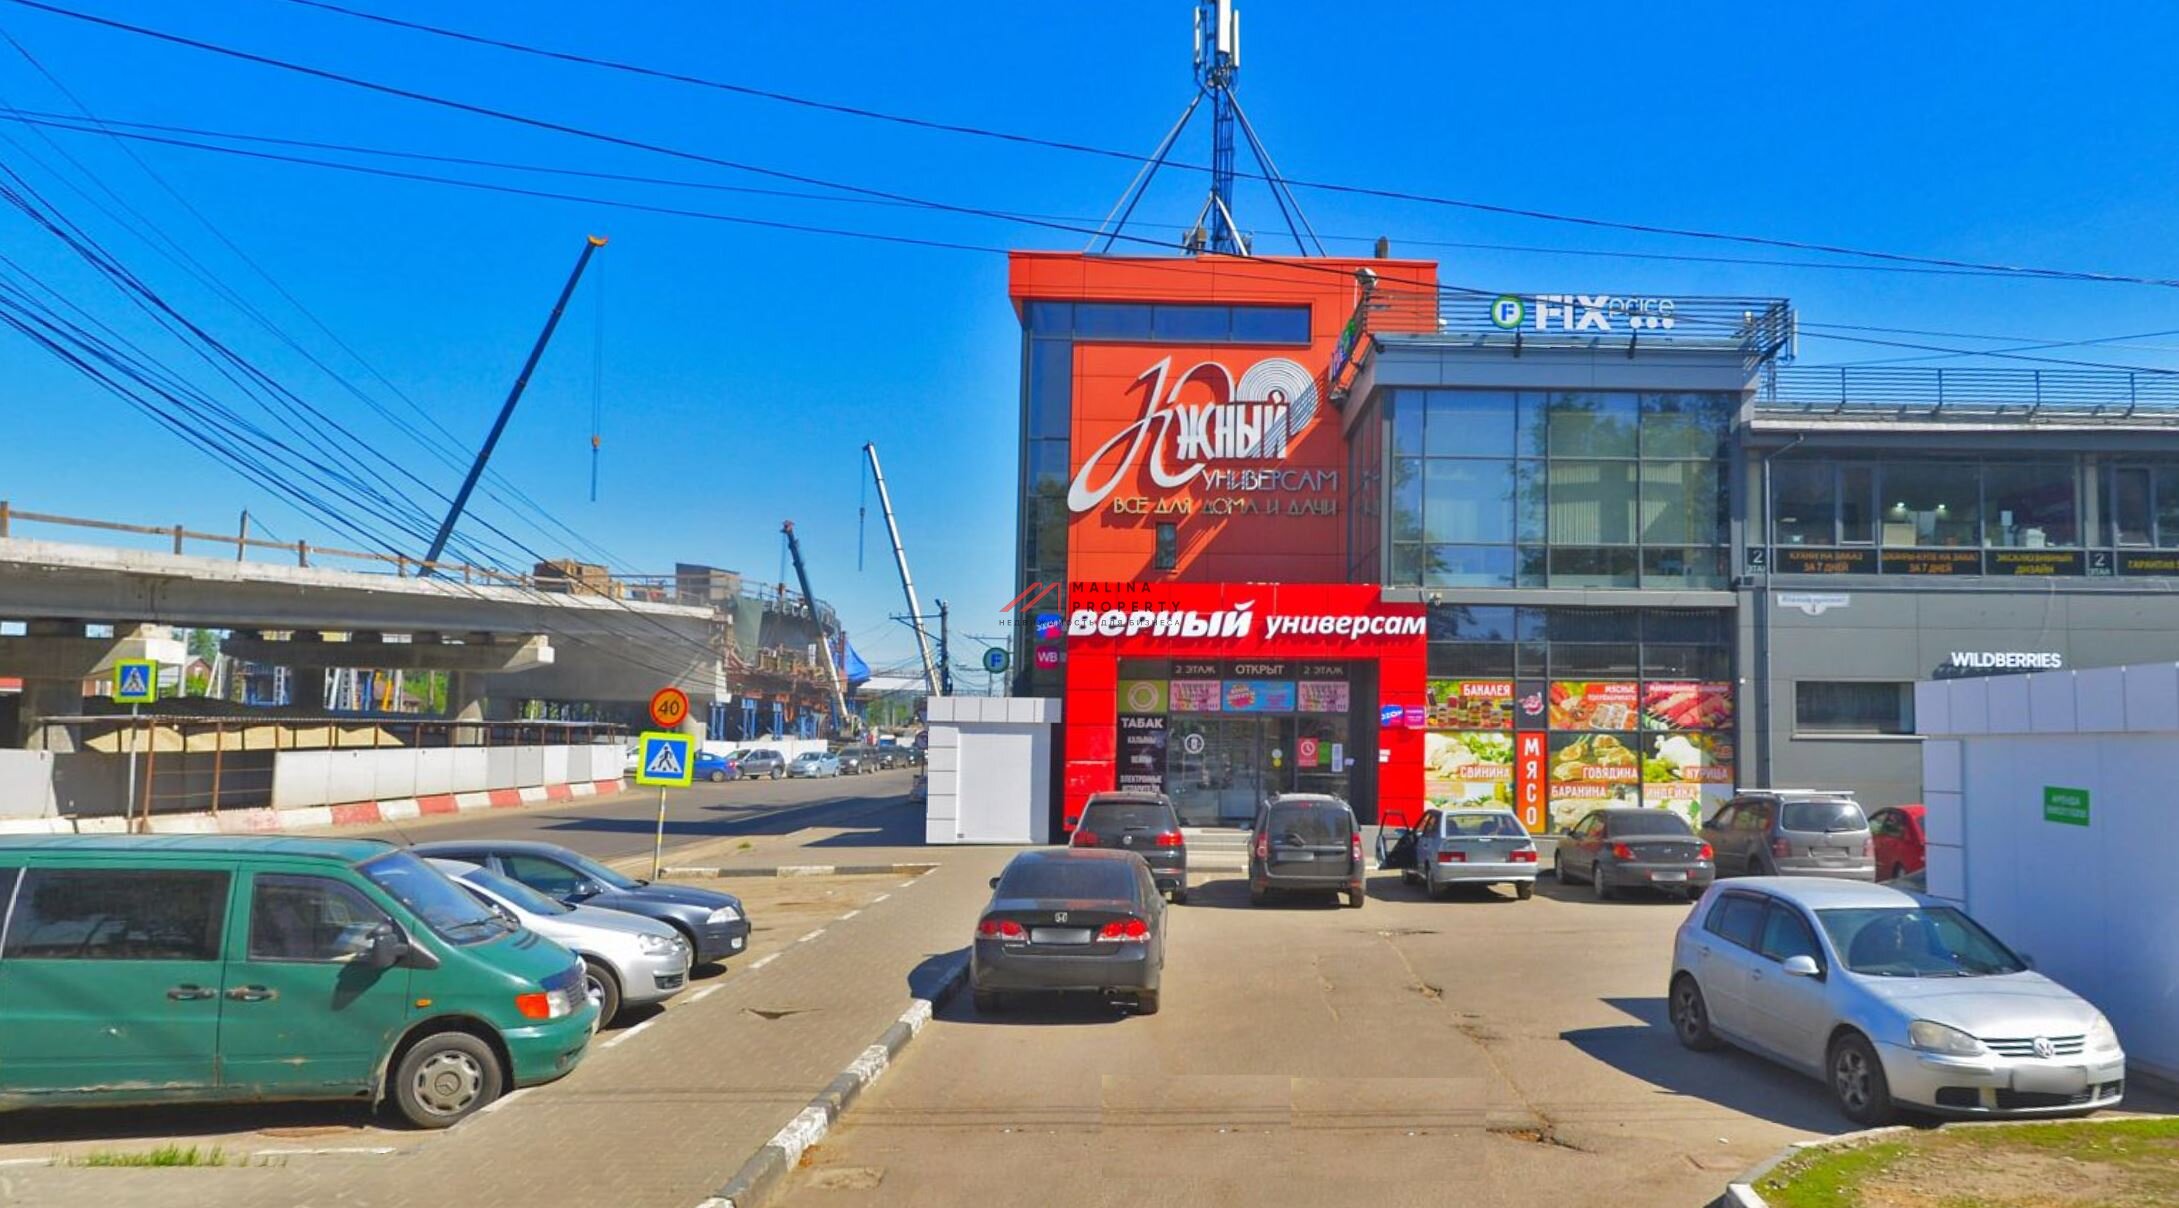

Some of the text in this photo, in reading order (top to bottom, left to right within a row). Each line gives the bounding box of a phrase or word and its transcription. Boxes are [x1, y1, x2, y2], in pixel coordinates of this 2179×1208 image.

[1202, 468, 1338, 492] УНИВЕРСАМ
[1113, 497, 1337, 516] ВСЕ ДЛЯ ДОМА И ДАЧИ
[1752, 550, 1764, 563] 2
[2093, 553, 2105, 567] 2
[1265, 614, 1427, 640] универсам
[1951, 651, 2062, 668] WILDBERRIES
[1175, 666, 1216, 675] 2 ЭТАЖ
[1235, 664, 1285, 675] ОТКРЫТ
[1303, 666, 1345, 675] 2 ЭТАЖ
[1463, 684, 1511, 697] БАКАЛЕЯ
[657, 700, 680, 716] 40
[1121, 717, 1164, 729] ТАБАК
[1460, 766, 1511, 778] СВИНИНА
[1583, 766, 1639, 779] ГОВЯДИНА
[1524, 737, 1541, 826] МЯСО
[1550, 785, 1607, 798] БАРАНИНА
